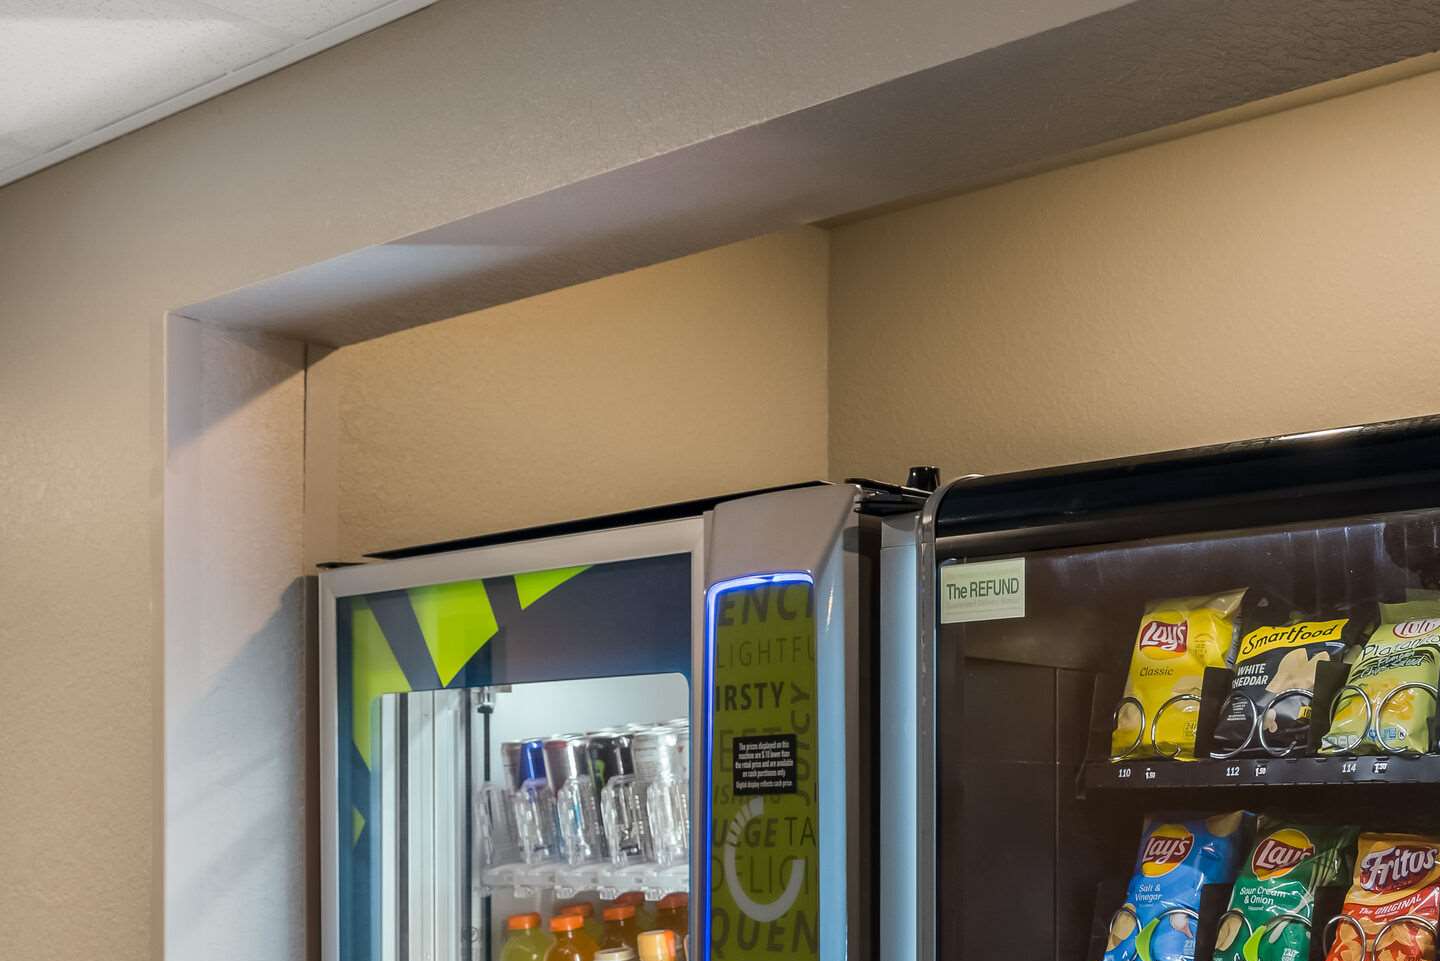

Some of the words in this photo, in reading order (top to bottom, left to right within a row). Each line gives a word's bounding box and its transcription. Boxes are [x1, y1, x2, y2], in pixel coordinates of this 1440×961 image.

[946, 583, 968, 600] The
[969, 578, 1020, 598] REFUND
[1141, 622, 1187, 650] Lay's
[1242, 624, 1338, 655] Smartfood
[1139, 667, 1174, 677] Classic
[1237, 663, 1266, 676] WHITE
[1226, 767, 1240, 776] 112
[1342, 763, 1357, 772] 114
[1143, 838, 1190, 864] Lay's
[1361, 847, 1439, 888] Fritos
[1139, 884, 1153, 892] Salt
[1154, 884, 1161, 892] &
[1240, 887, 1256, 896] Sour
[1257, 887, 1287, 898] Cream
[1135, 893, 1163, 904] Vinegar
[1243, 896, 1250, 904] &
[1250, 895, 1275, 905] Onion
[1375, 894, 1422, 915] ORIGINAL
